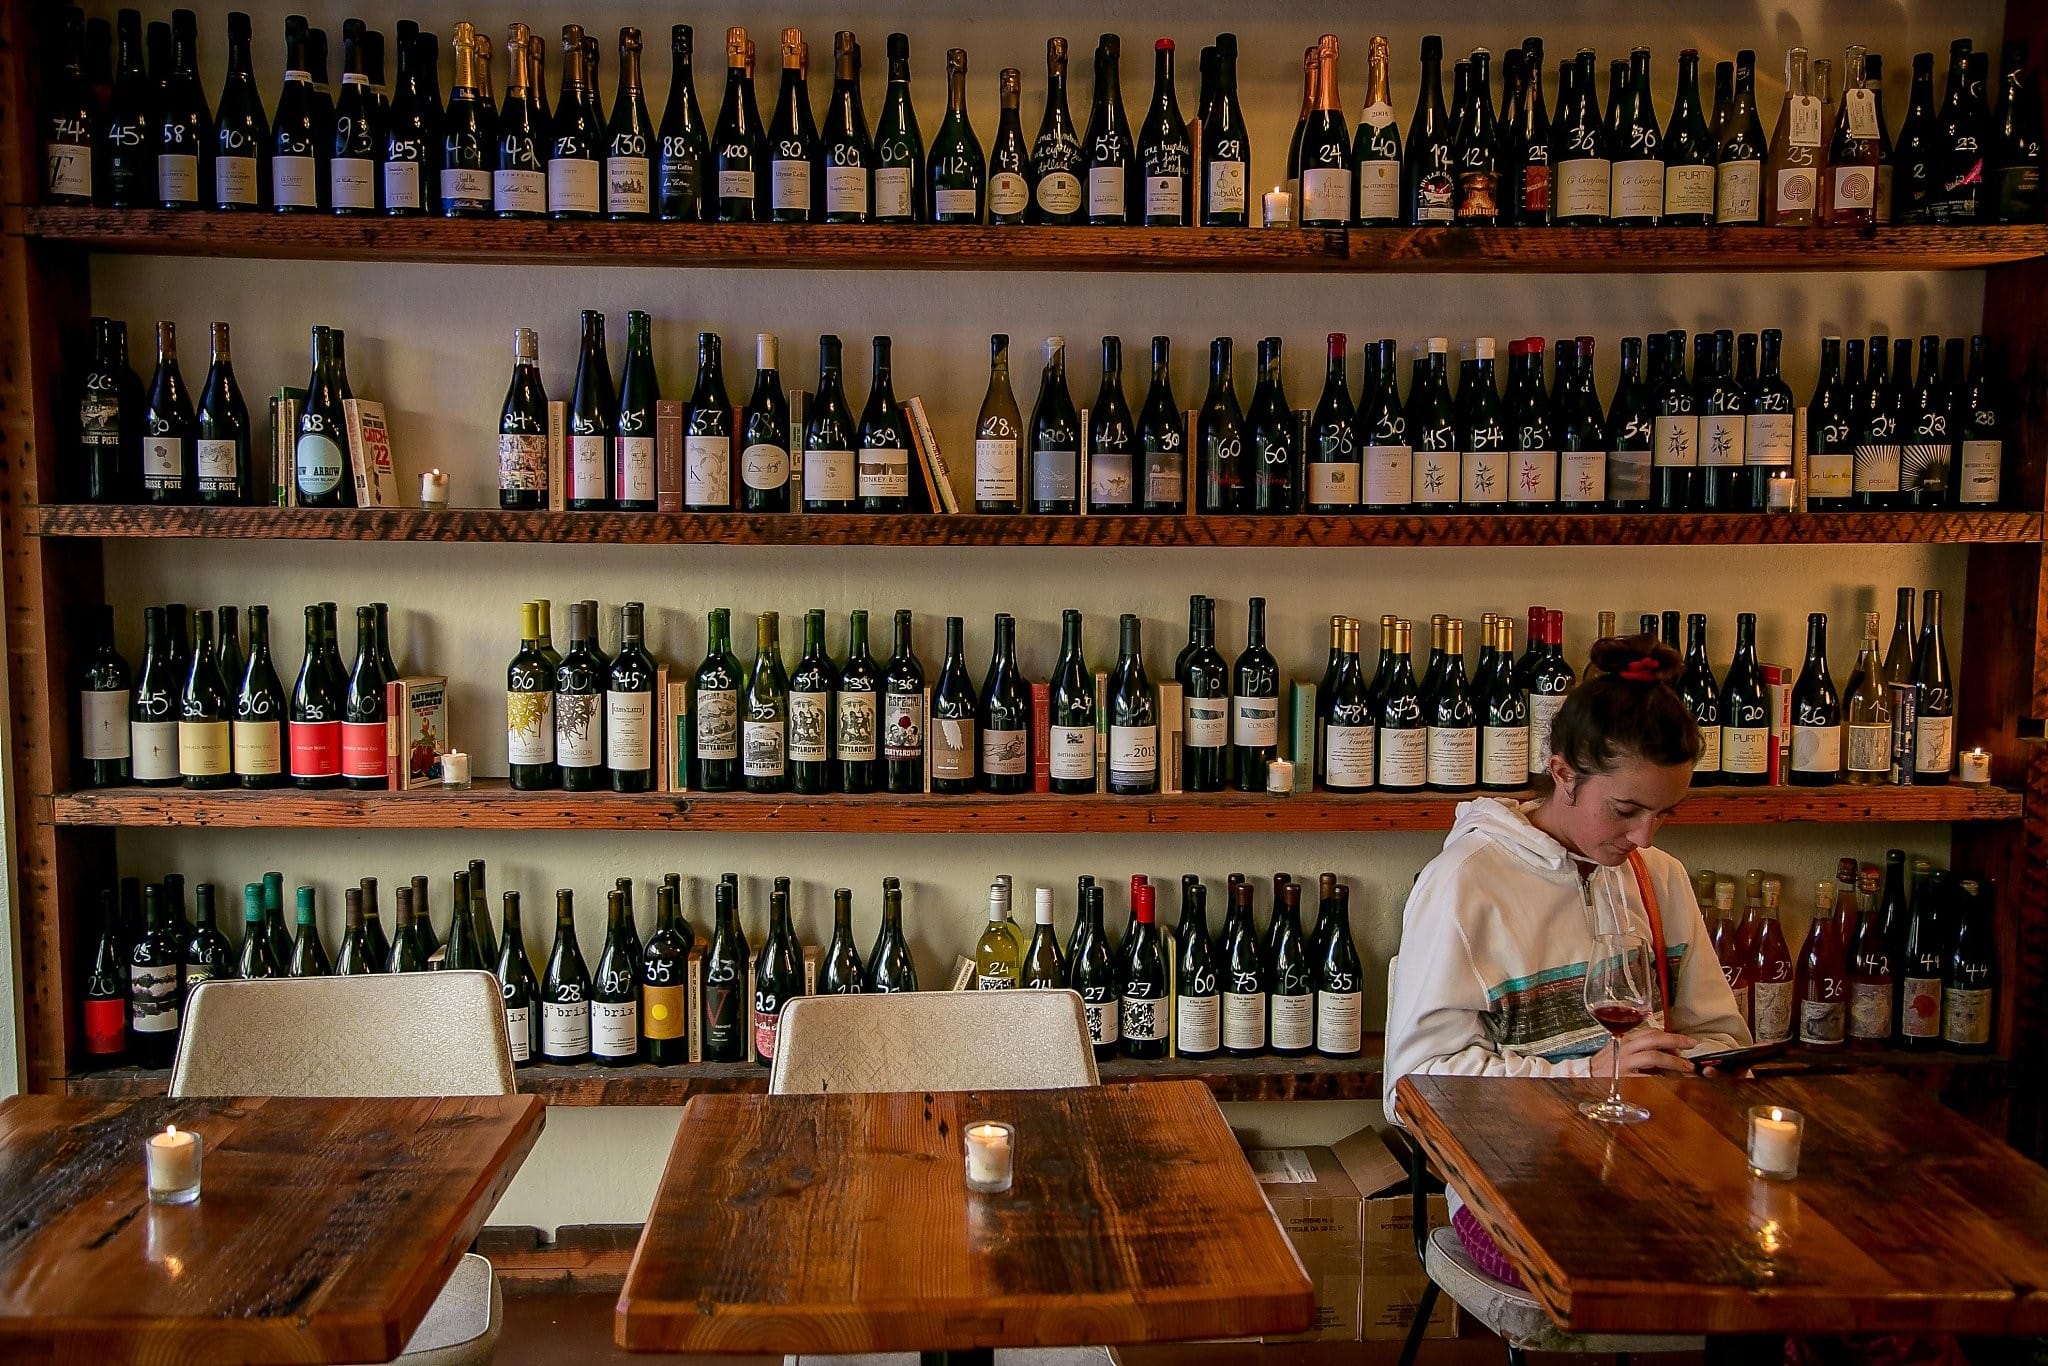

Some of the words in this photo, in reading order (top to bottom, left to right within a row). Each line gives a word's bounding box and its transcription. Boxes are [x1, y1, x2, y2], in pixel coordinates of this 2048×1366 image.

[53, 119, 83, 141] 74
[109, 124, 140, 146] 45
[164, 124, 186, 143] 58
[219, 130, 244, 148] 90
[388, 141, 417, 160] 105
[445, 133, 479, 163] 42
[506, 135, 541, 167] 42
[557, 137, 578, 155] 75
[610, 134, 646, 155] 130
[663, 137, 686, 158] 88
[723, 144, 754, 158] 100
[780, 141, 802, 158] 80
[880, 139, 908, 161] 60
[1217, 139, 1240, 159] 29
[1371, 134, 1396, 158] 40
[1954, 137, 1978, 151] 23
[834, 143, 860, 166] 80
[1000, 152, 1020, 170] 43
[1319, 144, 1341, 164] 24
[1462, 148, 1484, 167] 12
[1528, 146, 1549, 162] 25
[1786, 146, 1813, 166] 25
[1759, 393, 1786, 411] 72
[695, 408, 722, 432] 37
[987, 415, 1010, 437] 28
[1871, 417, 1897, 437] 24
[1919, 414, 1947, 437] 22
[102, 436, 119, 445] PISTE
[1161, 435, 1180, 450] 30
[1824, 425, 1849, 442] 27
[374, 444, 391, 466] 22
[1219, 438, 1241, 459] 60
[1263, 444, 1287, 464] 60
[314, 466, 341, 476] ARROW
[164, 481, 182, 489] PISTE
[619, 671, 642, 690] 45
[707, 671, 730, 690] 33
[136, 690, 169, 716] 45
[410, 690, 443, 701] ANTHONY
[304, 704, 324, 719] 36
[751, 702, 775, 720] 55
[944, 702, 963, 719] 21
[1338, 704, 1362, 724] 78
[1500, 699, 1526, 723] 60
[1696, 702, 1717, 722] 20
[1742, 705, 1765, 721] 20
[1133, 746, 1156, 758] 2013
[646, 960, 673, 983] 35
[988, 962, 1009, 976] 24
[1865, 953, 1888, 977] 42
[88, 975, 115, 996] 20
[1194, 966, 1215, 993] 60
[1232, 971, 1258, 991] 75
[1331, 973, 1354, 990] 35
[558, 984, 583, 1001] 28
[1086, 987, 1105, 1000] 27
[1126, 982, 1152, 998] 27
[557, 1005, 589, 1017] brix
[604, 1006, 635, 1018] brix
